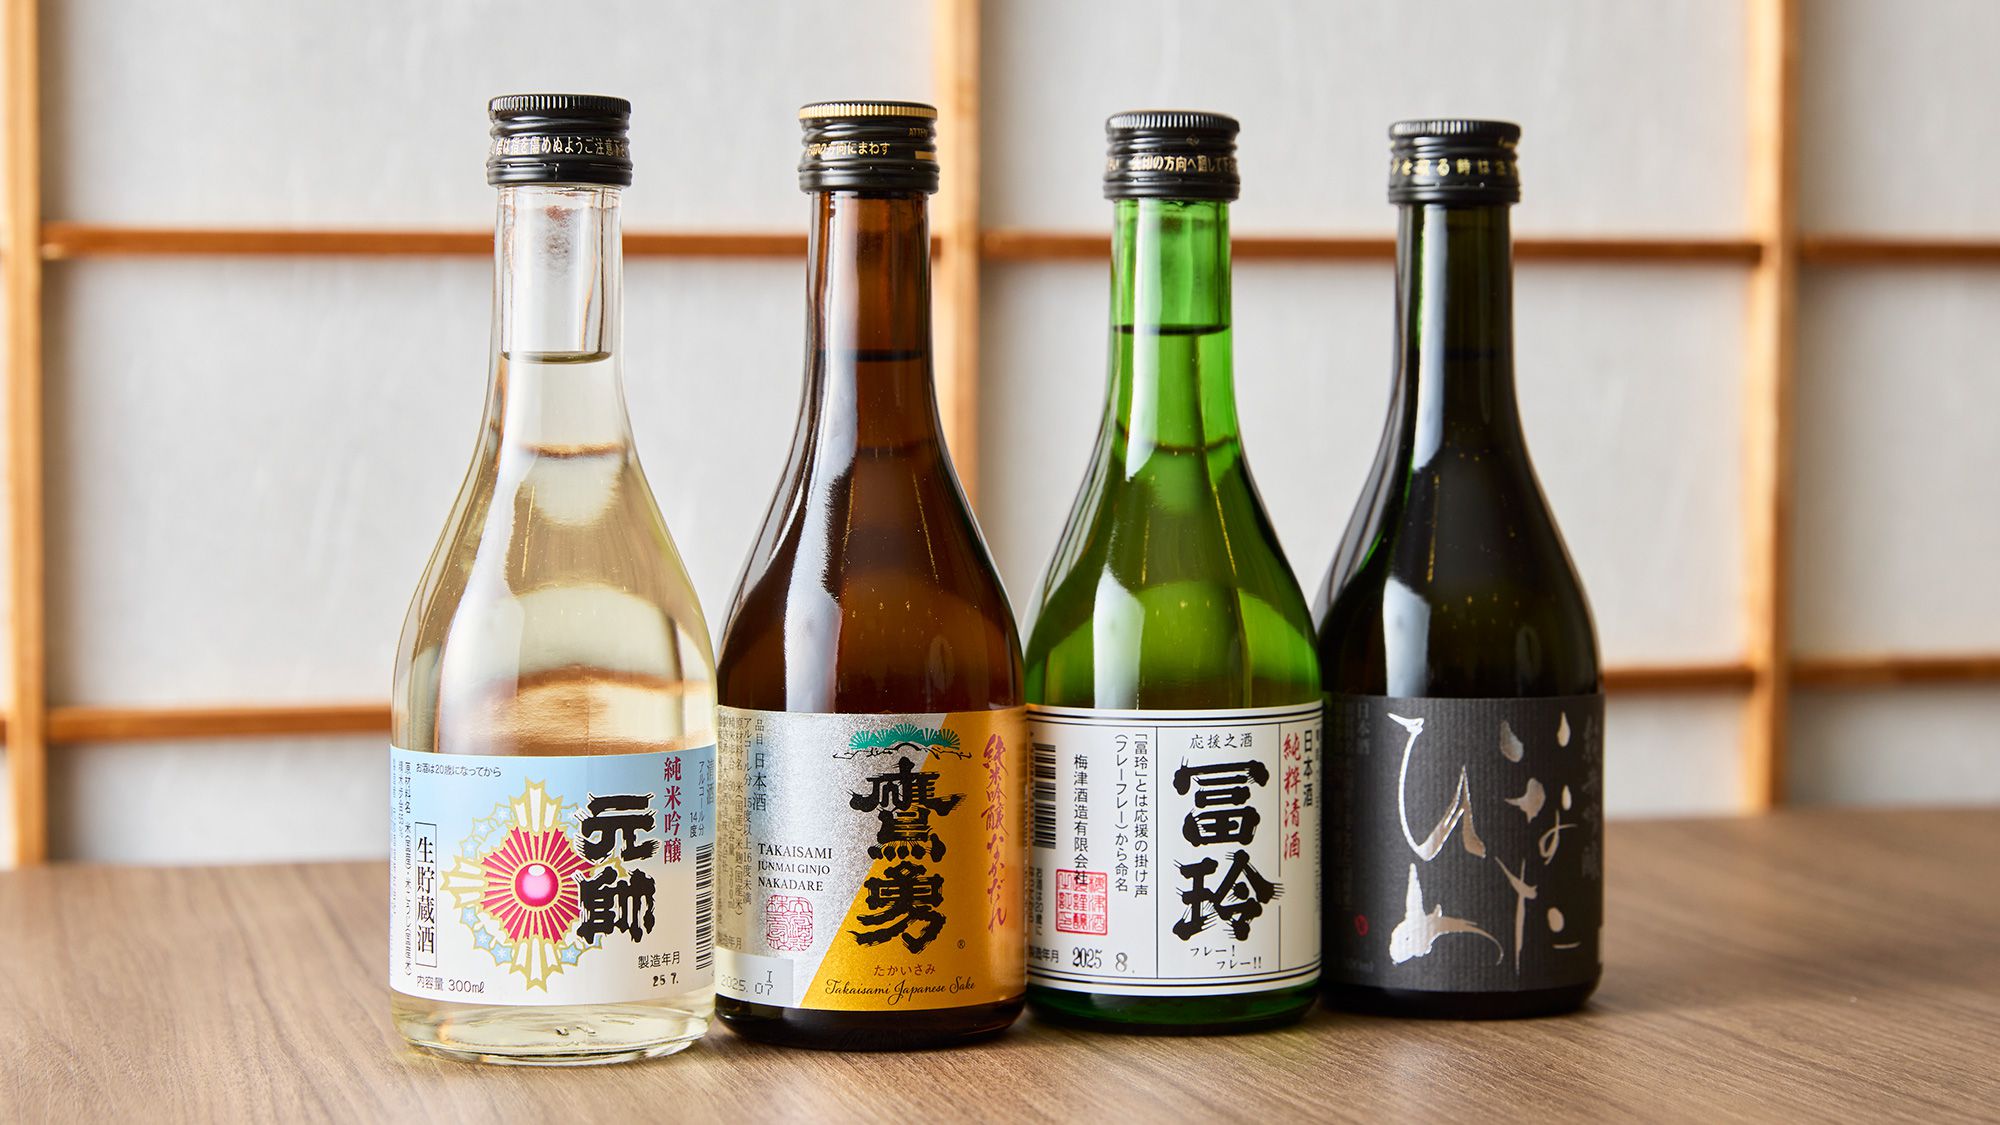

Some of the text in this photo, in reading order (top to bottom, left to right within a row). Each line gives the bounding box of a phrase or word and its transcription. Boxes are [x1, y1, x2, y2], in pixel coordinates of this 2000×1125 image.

[744, 717, 752, 786] アルコール分
[1189, 732, 1253, 749] 応援之酒
[753, 719, 766, 811] 品目 日本酒
[1304, 730, 1312, 807] 日本酒
[664, 756, 681, 864] 純米吟醸
[1074, 754, 1088, 885] 梅津酒造有限会社
[690, 811, 698, 838] 14度
[758, 843, 832, 859] TAKAISAMI
[847, 756, 967, 955] 鷹勇
[571, 793, 662, 943] 元帥
[758, 860, 831, 876] JUNMAI GINJO
[415, 836, 435, 955] 生貯蔵酒
[758, 876, 824, 892] NAKADARE
[638, 950, 680, 969] 製造年月
[873, 963, 936, 977] たかいさみ
[1072, 946, 1103, 969] 2025
[416, 975, 443, 991] 内容量
[754, 982, 774, 997] 07
[825, 975, 975, 1006] Takaisami Japanese Sake
